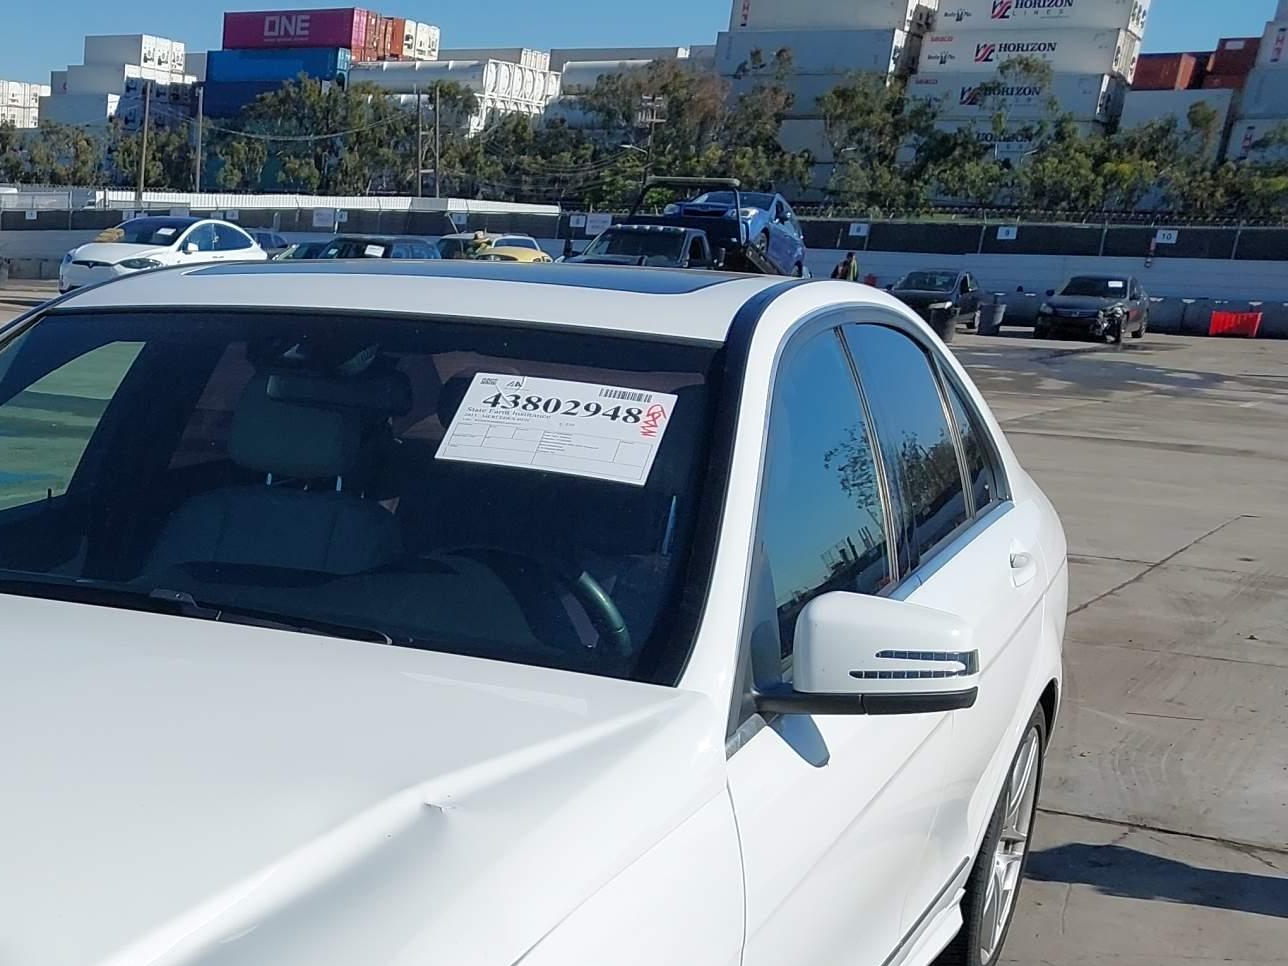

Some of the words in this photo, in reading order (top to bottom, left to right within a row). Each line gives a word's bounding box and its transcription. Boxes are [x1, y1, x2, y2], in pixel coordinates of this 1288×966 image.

[263, 14, 311, 36] ONE
[998, 42, 1057, 52] HORIZON
[1161, 232, 1172, 241] 10
[482, 392, 643, 424] 43802948
